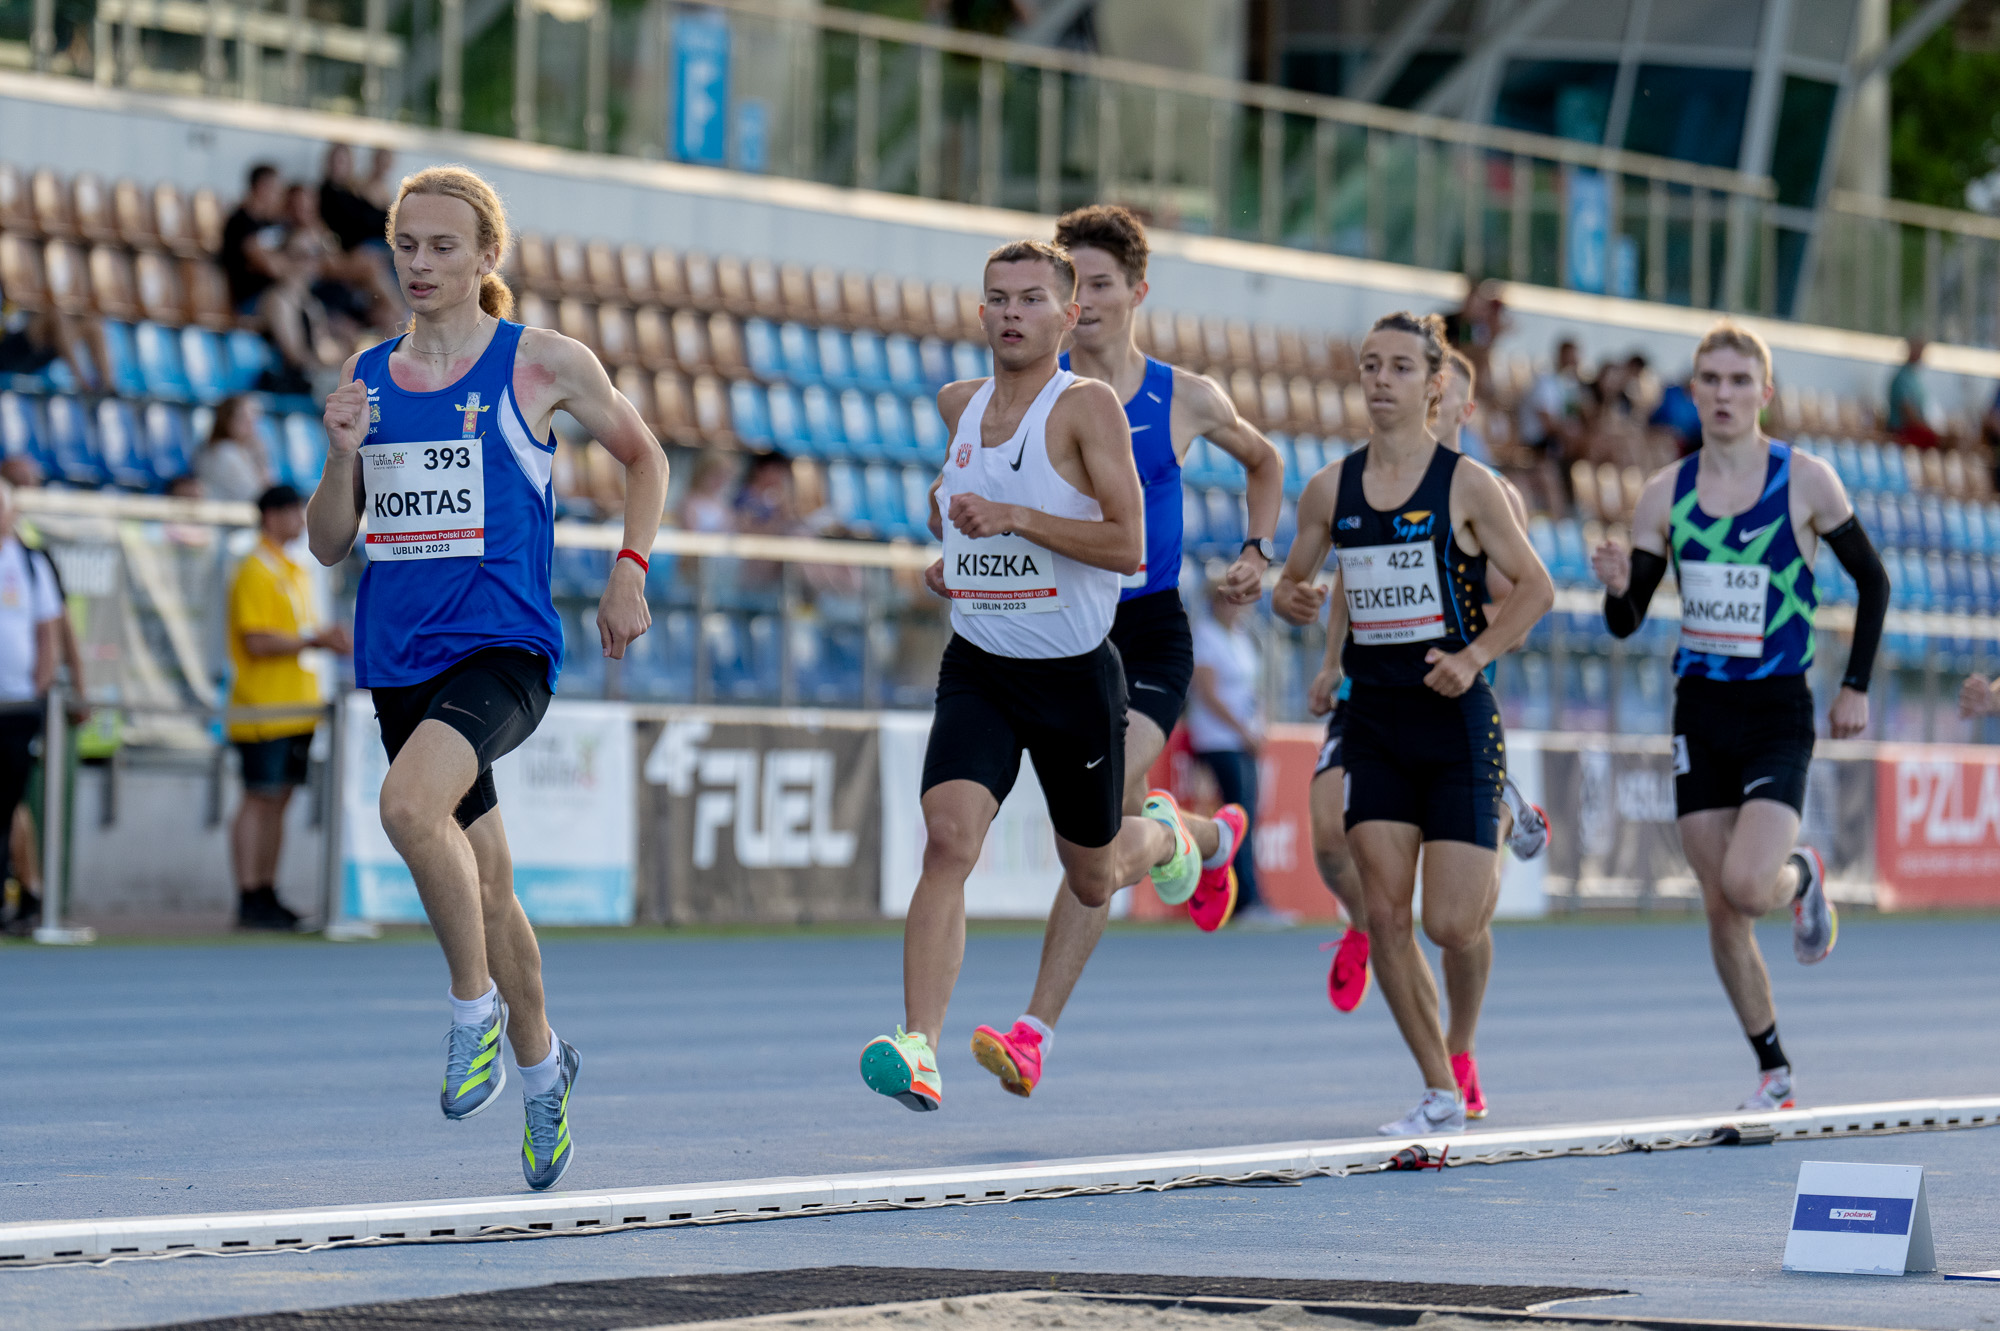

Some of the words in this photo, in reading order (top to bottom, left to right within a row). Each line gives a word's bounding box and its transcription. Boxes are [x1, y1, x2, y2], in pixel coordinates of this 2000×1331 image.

[424, 447, 470, 470] 393
[375, 489, 471, 517] KORTAS
[396, 533, 437, 541] Mistrzostwa
[438, 531, 460, 539] Polski
[461, 530, 475, 538] U20
[392, 545, 423, 555] LUBLIN
[425, 543, 450, 553] 2023
[957, 553, 1039, 576] KISZKA
[1387, 550, 1424, 570] 422
[1725, 570, 1759, 589] 163
[951, 590, 960, 598] 77.
[1035, 589, 1049, 597] U20
[1345, 583, 1436, 609] TEIXEIRA
[972, 602, 1001, 611] LUBLIN
[1002, 602, 1026, 611] 2023
[1683, 599, 1761, 623] ANCARZ
